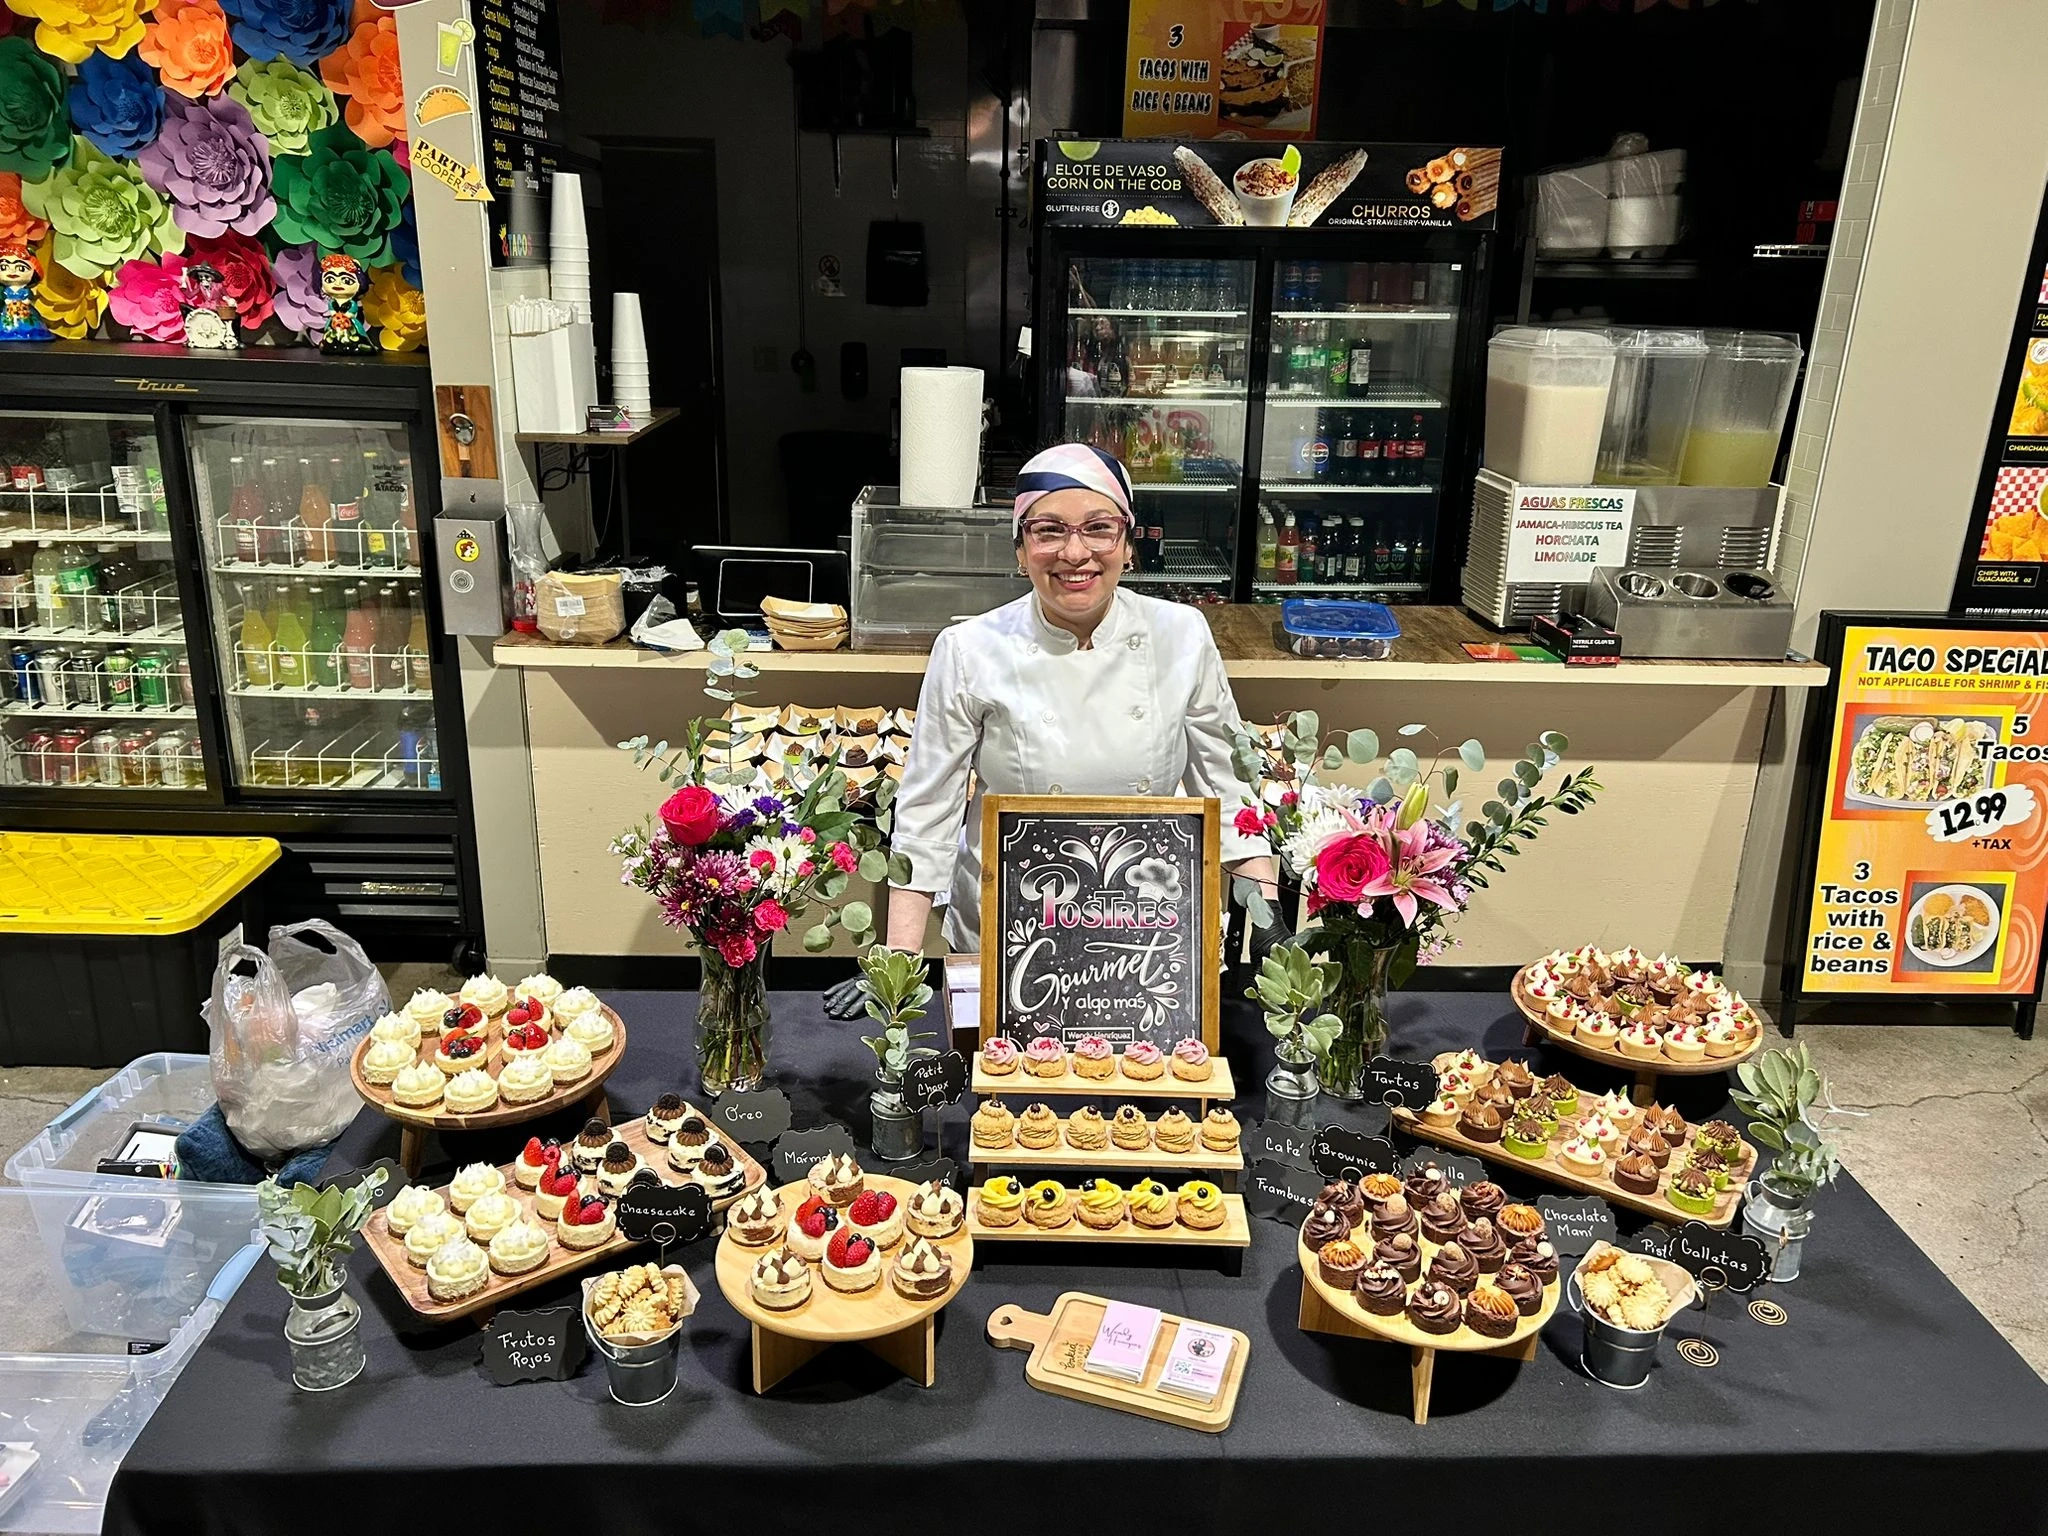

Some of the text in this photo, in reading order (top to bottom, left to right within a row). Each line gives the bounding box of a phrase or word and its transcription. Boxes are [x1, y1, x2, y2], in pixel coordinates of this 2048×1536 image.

[484, 6, 497, 22] Carne
[1168, 24, 1184, 49] 3
[486, 42, 500, 61] Tinga
[1139, 58, 1210, 82] TACOS WITH
[1132, 91, 1213, 115] RICE & BEANS
[417, 140, 470, 179] PARTY
[413, 153, 462, 189] POOPER
[1056, 164, 1167, 177] ELOTE DE VASO
[1047, 177, 1181, 191] CORN ON THE COB
[1046, 204, 1100, 213] GLUTTEN FREE
[1352, 204, 1431, 218] CHURROS
[120, 378, 196, 392] true
[1520, 496, 1624, 510] AGUAS FRESCAS
[1516, 520, 1623, 530] JAMAICA-HIBISCUS TEA
[1536, 535, 1600, 546] HORCHATA
[1534, 551, 1597, 563] LIMONADE
[1867, 647, 1935, 673] TACO
[1858, 677, 1881, 687] NOT
[1884, 677, 1950, 687] APPLICABLE
[1954, 679, 1975, 688] FOR
[1979, 679, 2020, 689] SHRIMP
[2024, 681, 2031, 689] &
[2013, 716, 2028, 734] 5
[1977, 741, 2048, 761] Tacos
[1940, 792, 2007, 837] 12.99
[1972, 839, 2011, 850] +TAX
[1855, 863, 1870, 880] 3
[1821, 885, 1898, 904] Tacos
[1828, 909, 1884, 927] with
[1813, 932, 1891, 950] rice &
[1009, 932, 1182, 1013] Gourmet
[1811, 955, 1888, 973] beans
[1075, 994, 1111, 1015] algo
[1113, 992, 1146, 1010] más
[312, 1014, 374, 1052] Walmart
[1371, 1071, 1420, 1090] Tartas
[724, 1104, 763, 1122] Oreo
[1265, 1136, 1305, 1157] Café
[1318, 1142, 1378, 1170] Brownie
[620, 1202, 696, 1217] Cheesecake
[1544, 1207, 1609, 1223] Chocolate
[1556, 1223, 1594, 1238] Maní
[1681, 1238, 1748, 1272] Galletas
[497, 1330, 556, 1348] Frutos
[508, 1351, 552, 1369] Rojos
